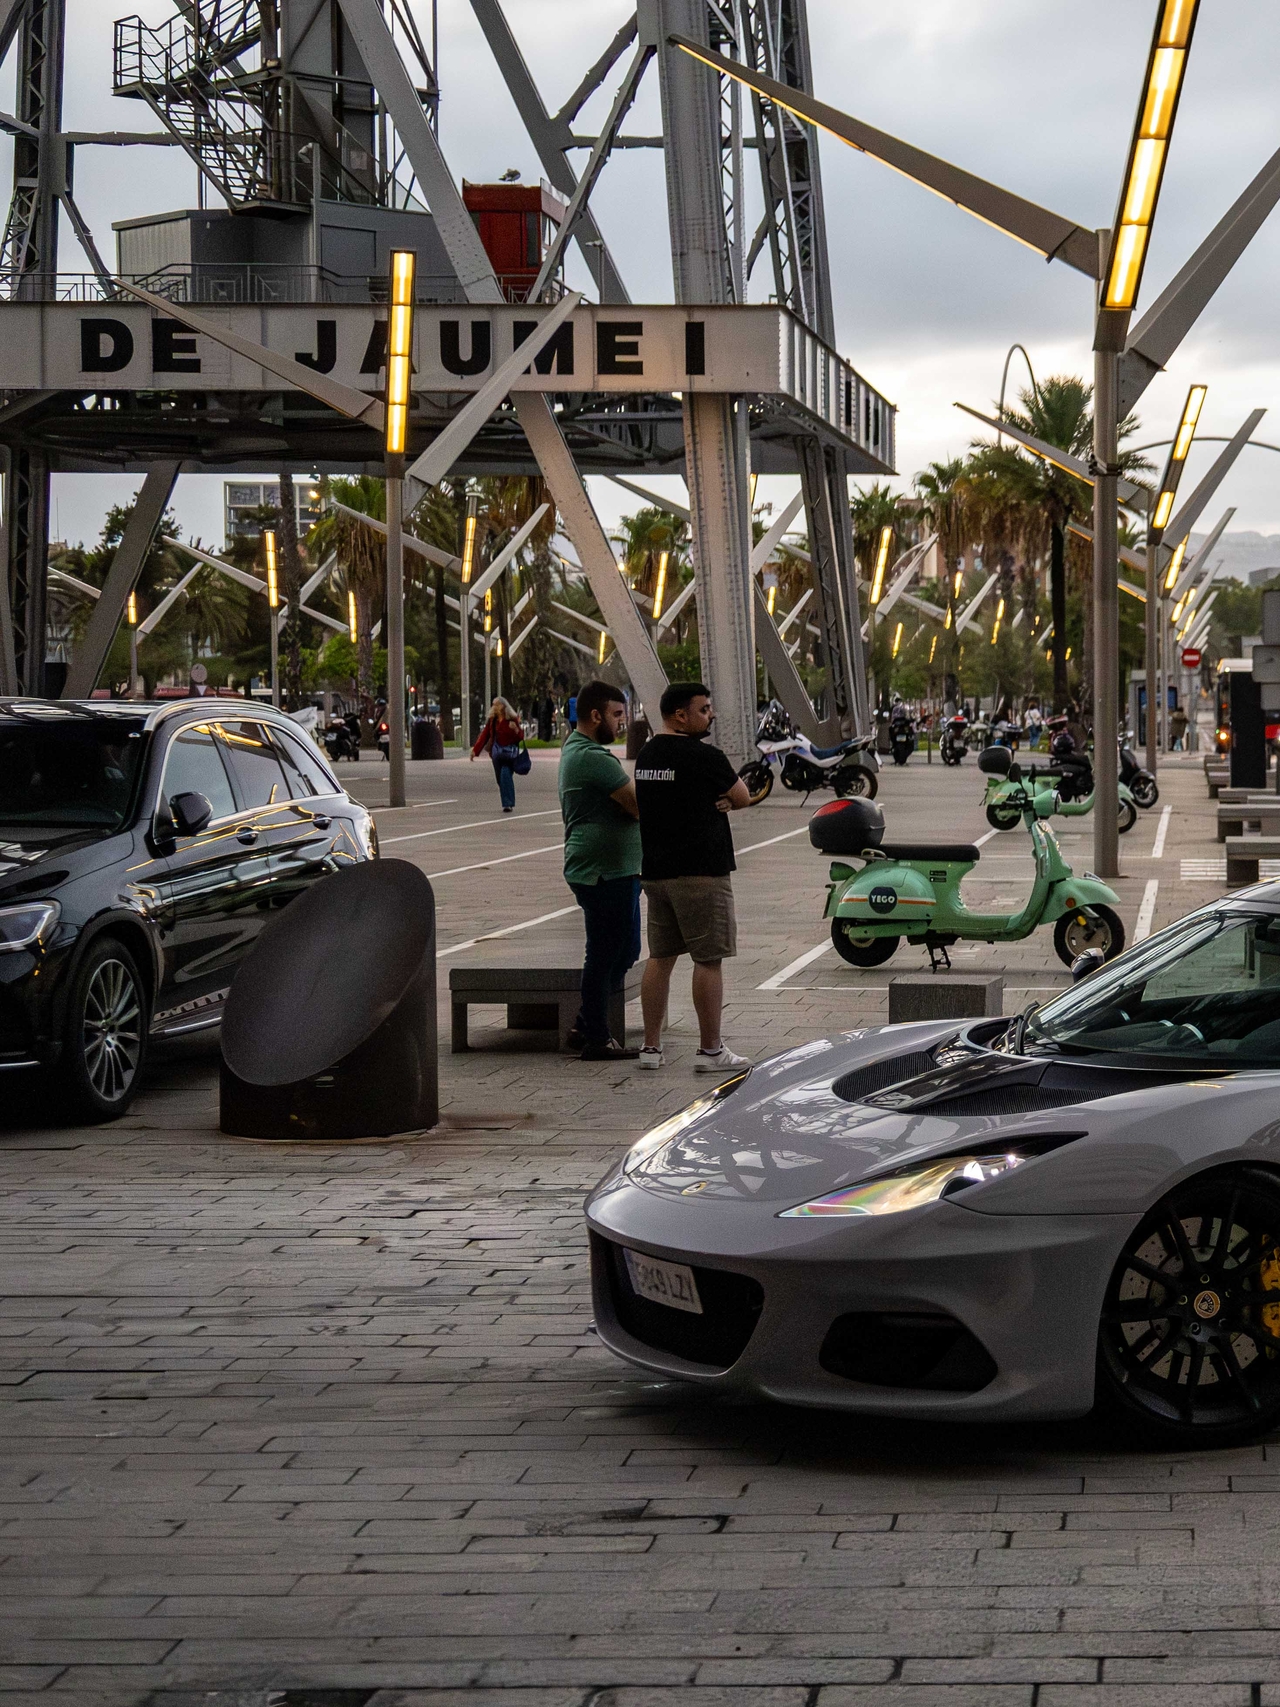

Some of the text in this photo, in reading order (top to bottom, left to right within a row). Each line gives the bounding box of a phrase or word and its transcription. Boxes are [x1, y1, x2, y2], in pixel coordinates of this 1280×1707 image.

[80, 318, 705, 375] DE JAUME I
[871, 895, 896, 904] YEGO
